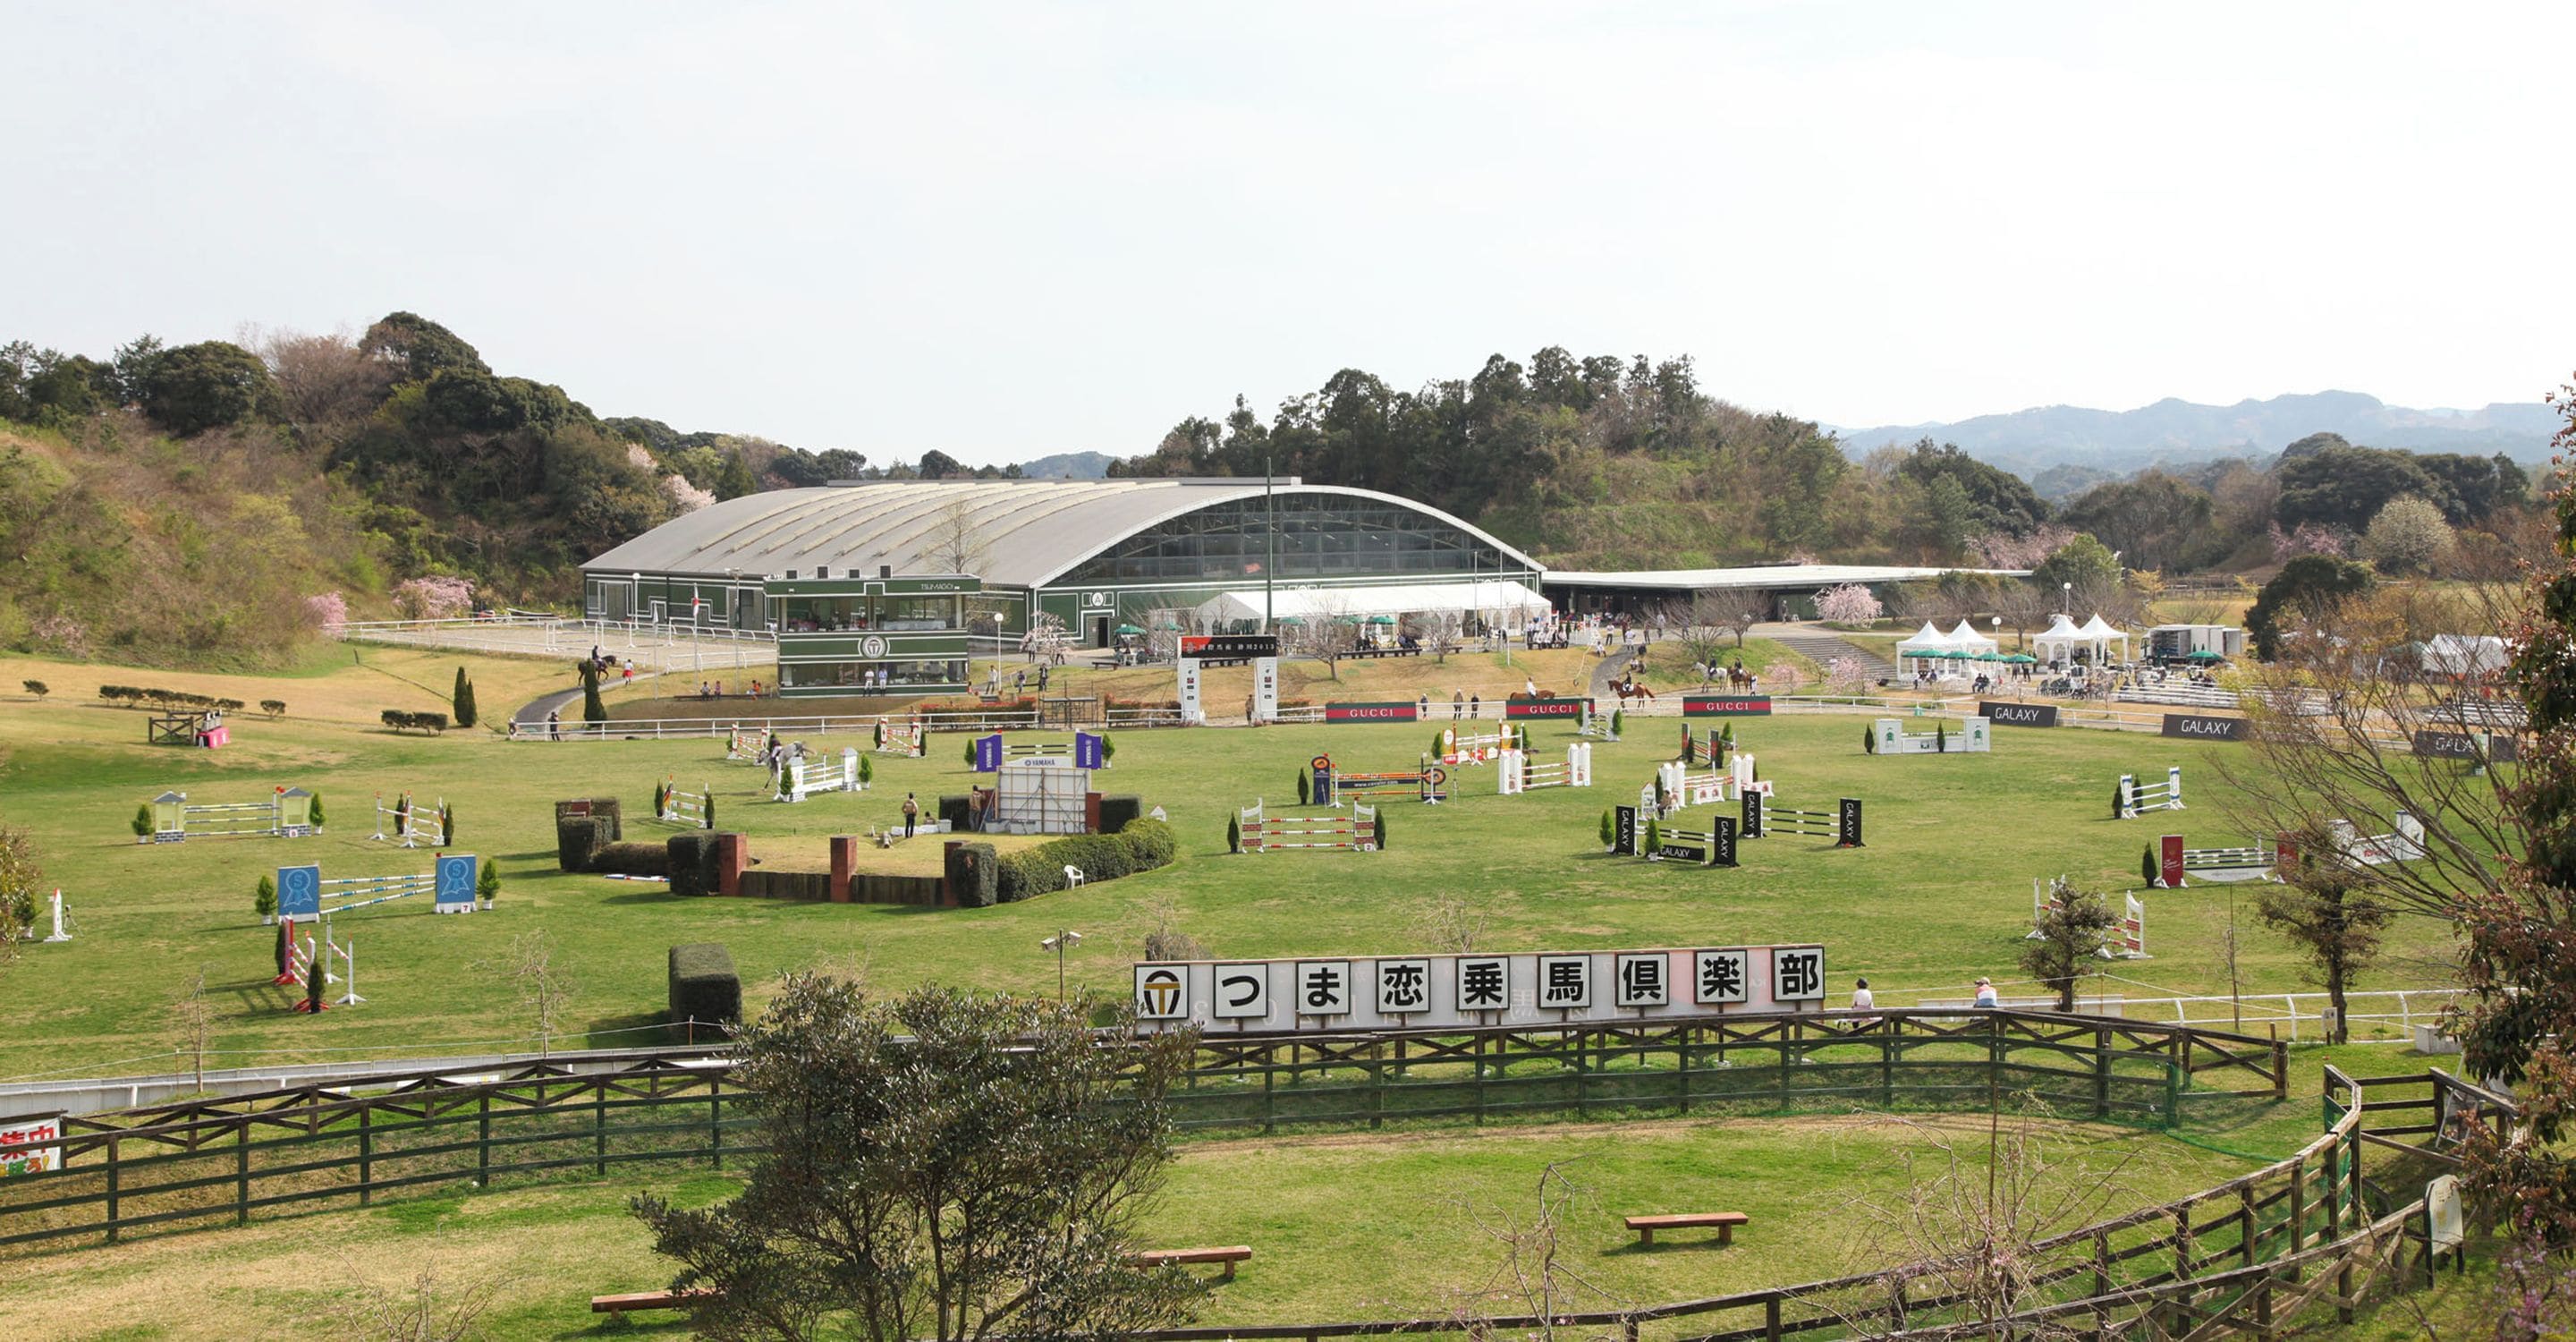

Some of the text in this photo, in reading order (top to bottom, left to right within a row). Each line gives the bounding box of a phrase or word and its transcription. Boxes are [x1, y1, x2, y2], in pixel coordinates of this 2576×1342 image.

[1350, 709, 1393, 718] GUCCI
[1530, 704, 1572, 714] GUCCI
[1707, 702, 1749, 711] GUCCI
[1995, 707, 2039, 721] GALAXY
[2182, 719, 2232, 735] GALAXY
[2435, 735, 2475, 752] GALA
[1747, 794, 1755, 830] GALAXY
[1846, 802, 1854, 838] GALAXY
[1621, 810, 1629, 846] GALAXY
[1721, 820, 1729, 858] GALAXY
[1660, 846, 1690, 858] GALAXY
[1222, 954, 1818, 1007] つま恋乗馬倶楽部
